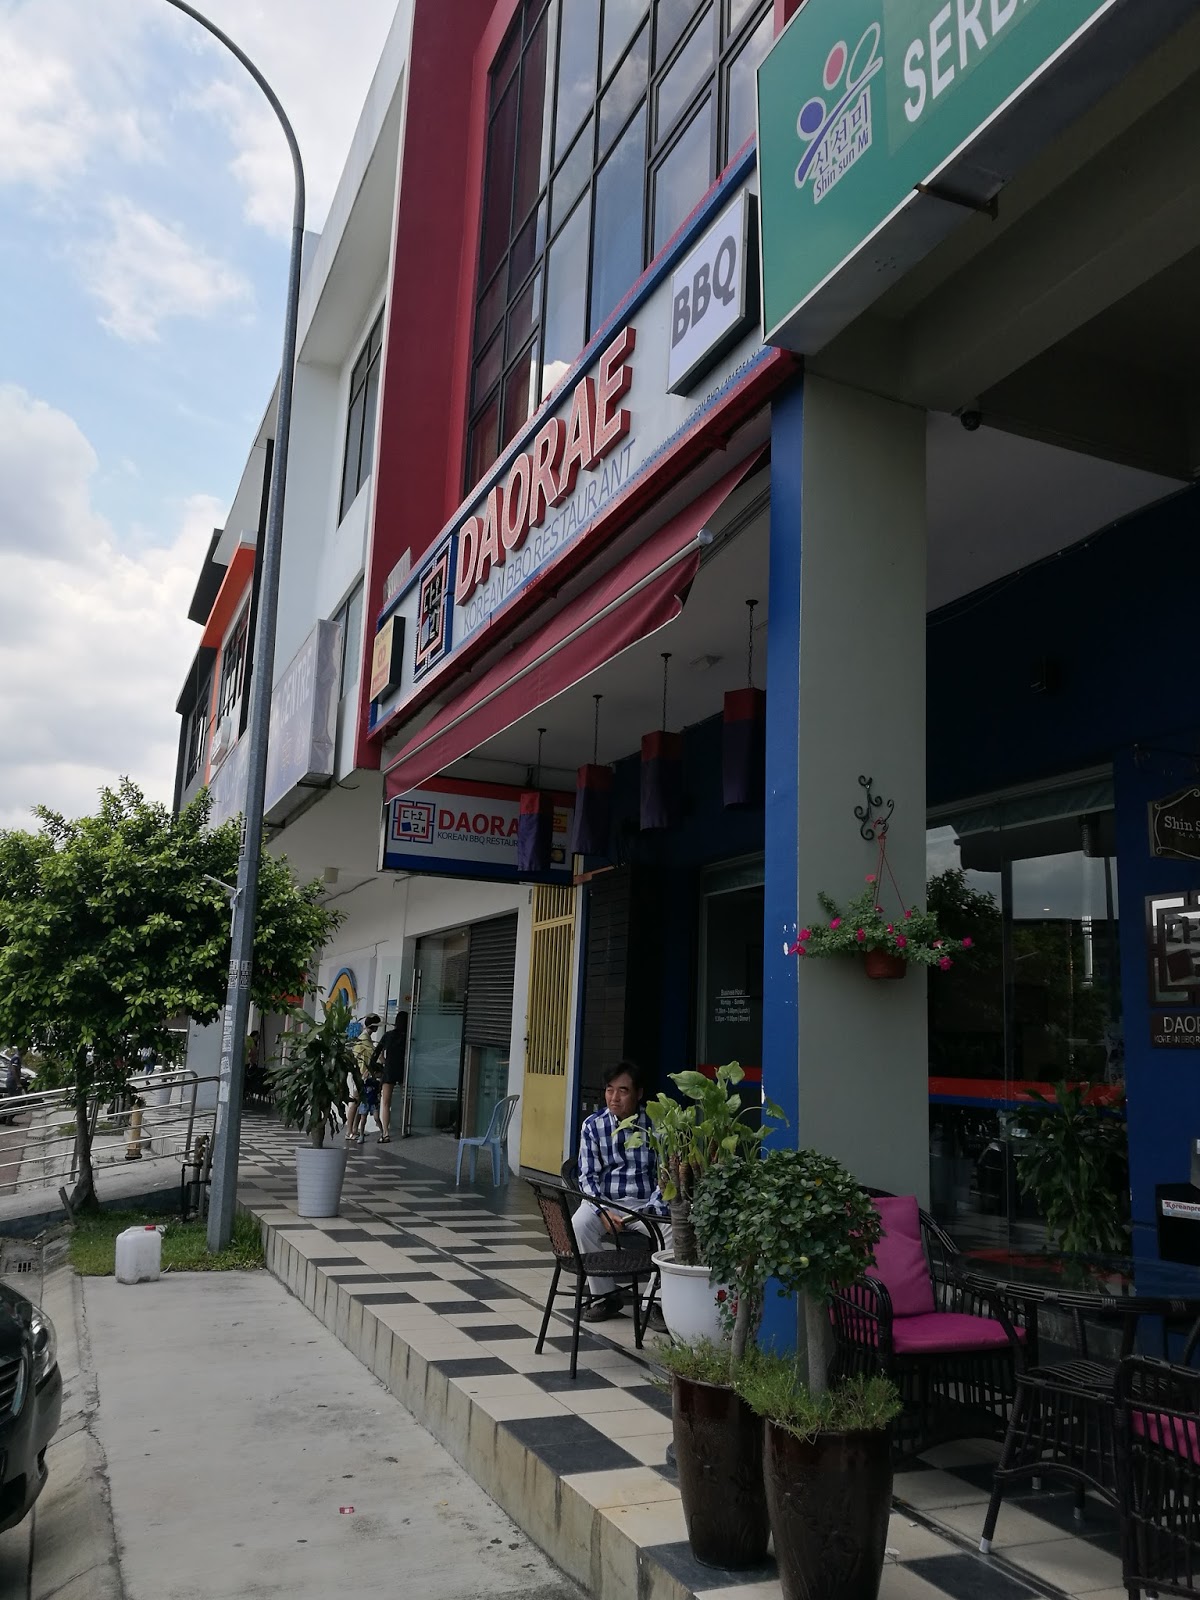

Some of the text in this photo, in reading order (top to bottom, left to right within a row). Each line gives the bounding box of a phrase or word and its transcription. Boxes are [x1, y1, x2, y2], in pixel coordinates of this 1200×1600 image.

[816, 127, 869, 198] Shin sun Mi
[672, 235, 737, 350] BBQ
[455, 326, 636, 606] DAORAE
[463, 572, 505, 636] KOREAN
[534, 438, 636, 568] RESTAURANT
[437, 831, 468, 842] KOREAN
[470, 834, 485, 845] BBQ
[1164, 815, 1193, 831] Shin
